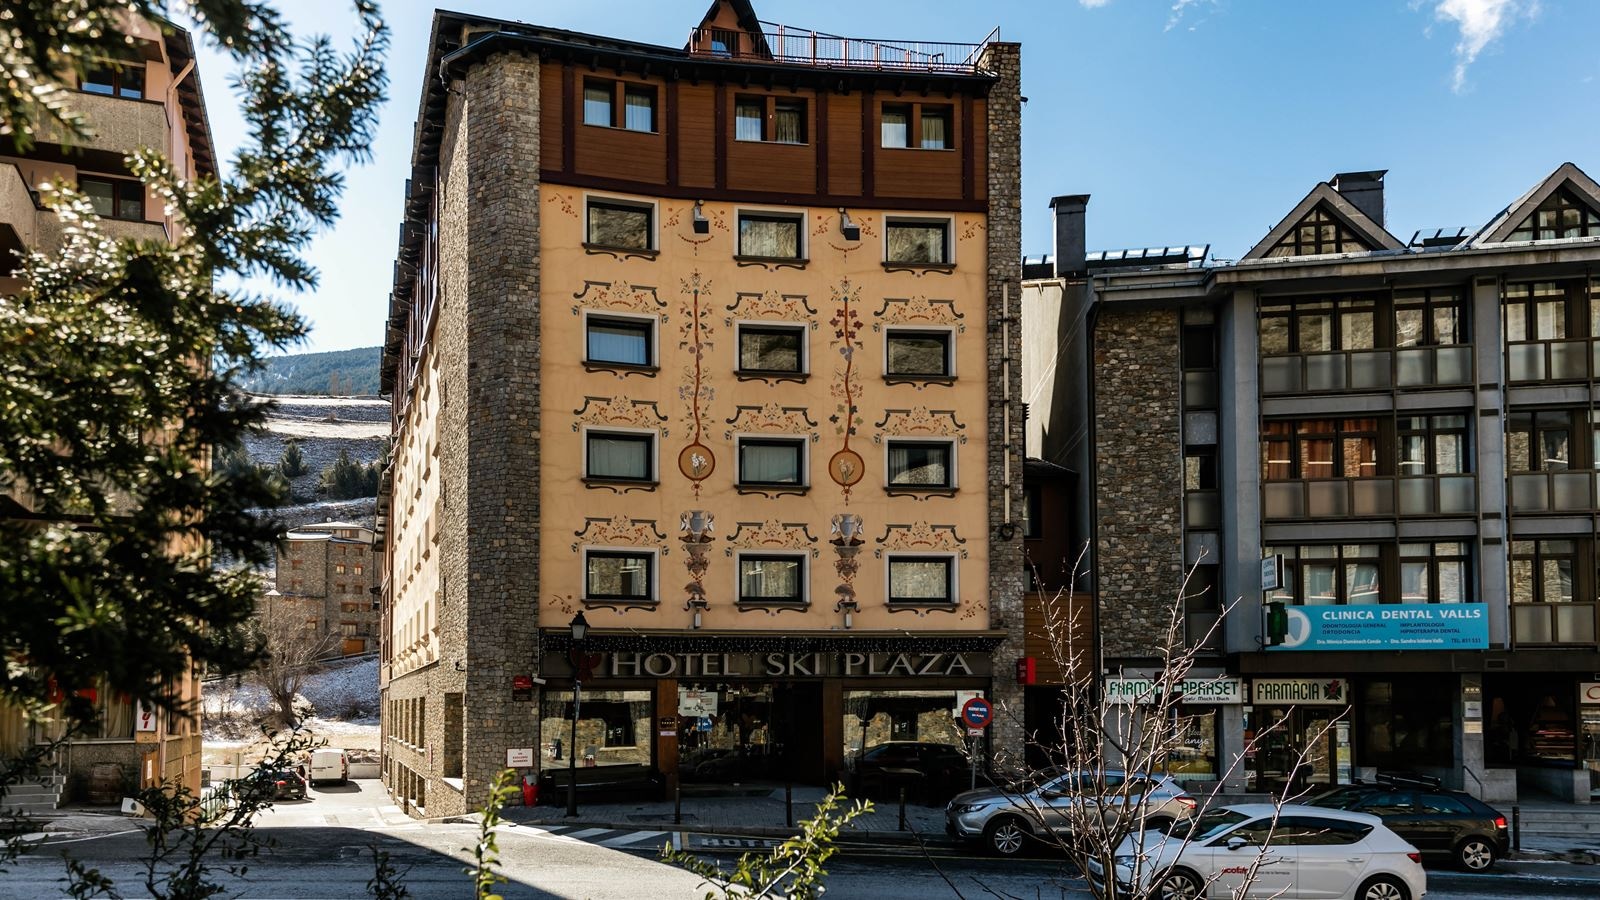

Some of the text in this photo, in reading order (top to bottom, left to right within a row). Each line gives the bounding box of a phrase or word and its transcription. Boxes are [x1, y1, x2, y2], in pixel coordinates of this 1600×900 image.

[1322, 609, 1481, 620] CLINICA DENTAL VALLS
[612, 653, 973, 676] HOTEL SKI PLAZA
[1257, 680, 1320, 700] FARMÀCIA
